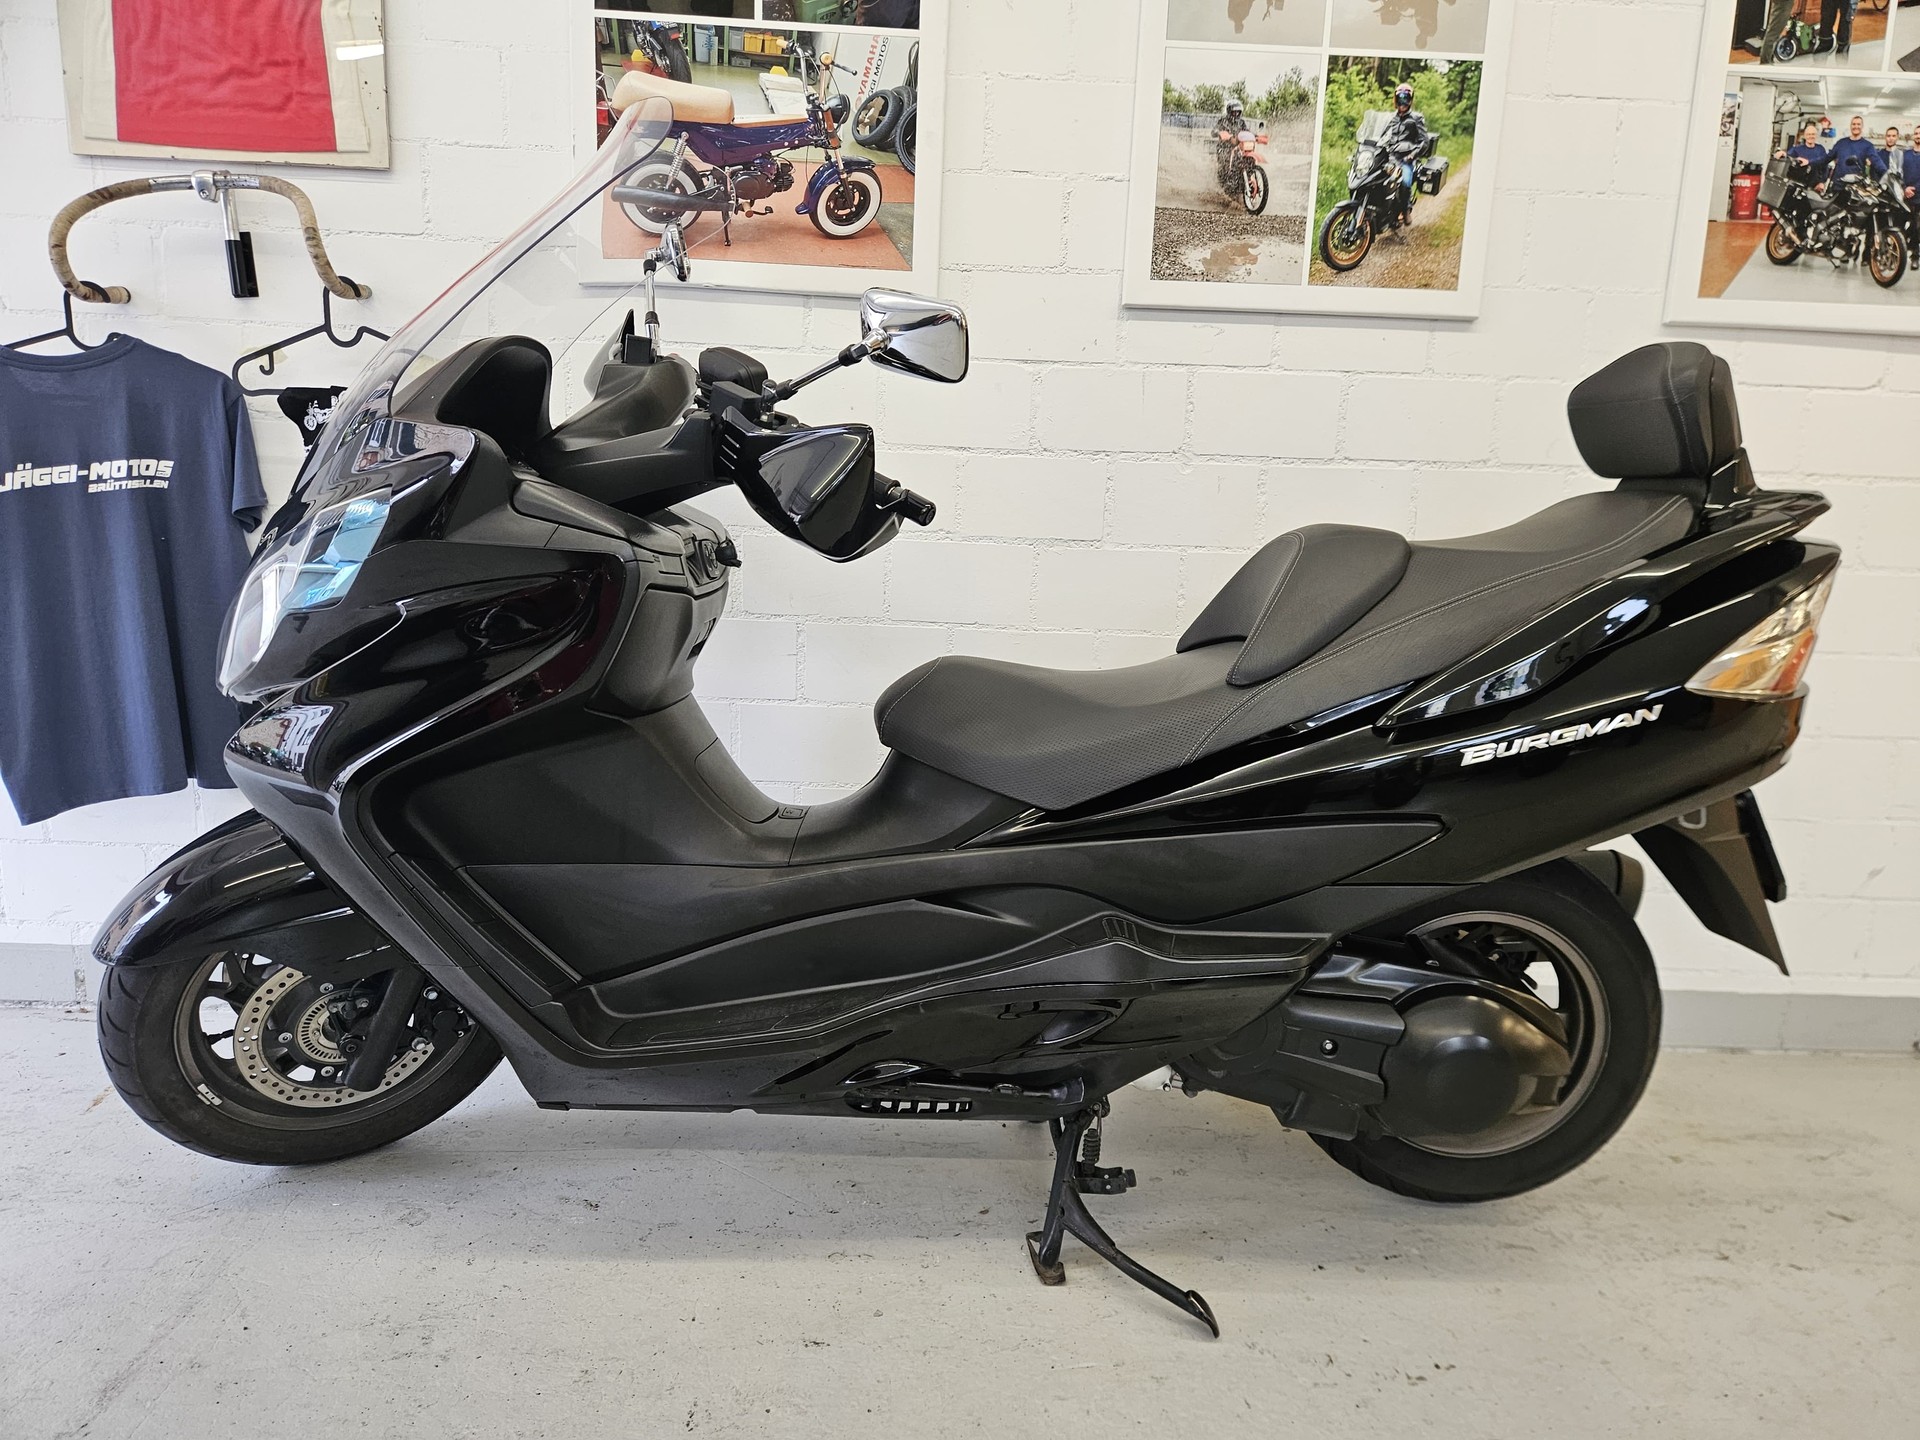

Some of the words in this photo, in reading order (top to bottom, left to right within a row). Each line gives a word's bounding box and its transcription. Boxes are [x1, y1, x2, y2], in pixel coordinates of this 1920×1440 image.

[858, 34, 881, 98] YAMAHA
[875, 36, 889, 77] MOTOS
[0, 459, 174, 492] JÄGGI-MOTOS
[1460, 703, 1664, 767] BURGMAN
